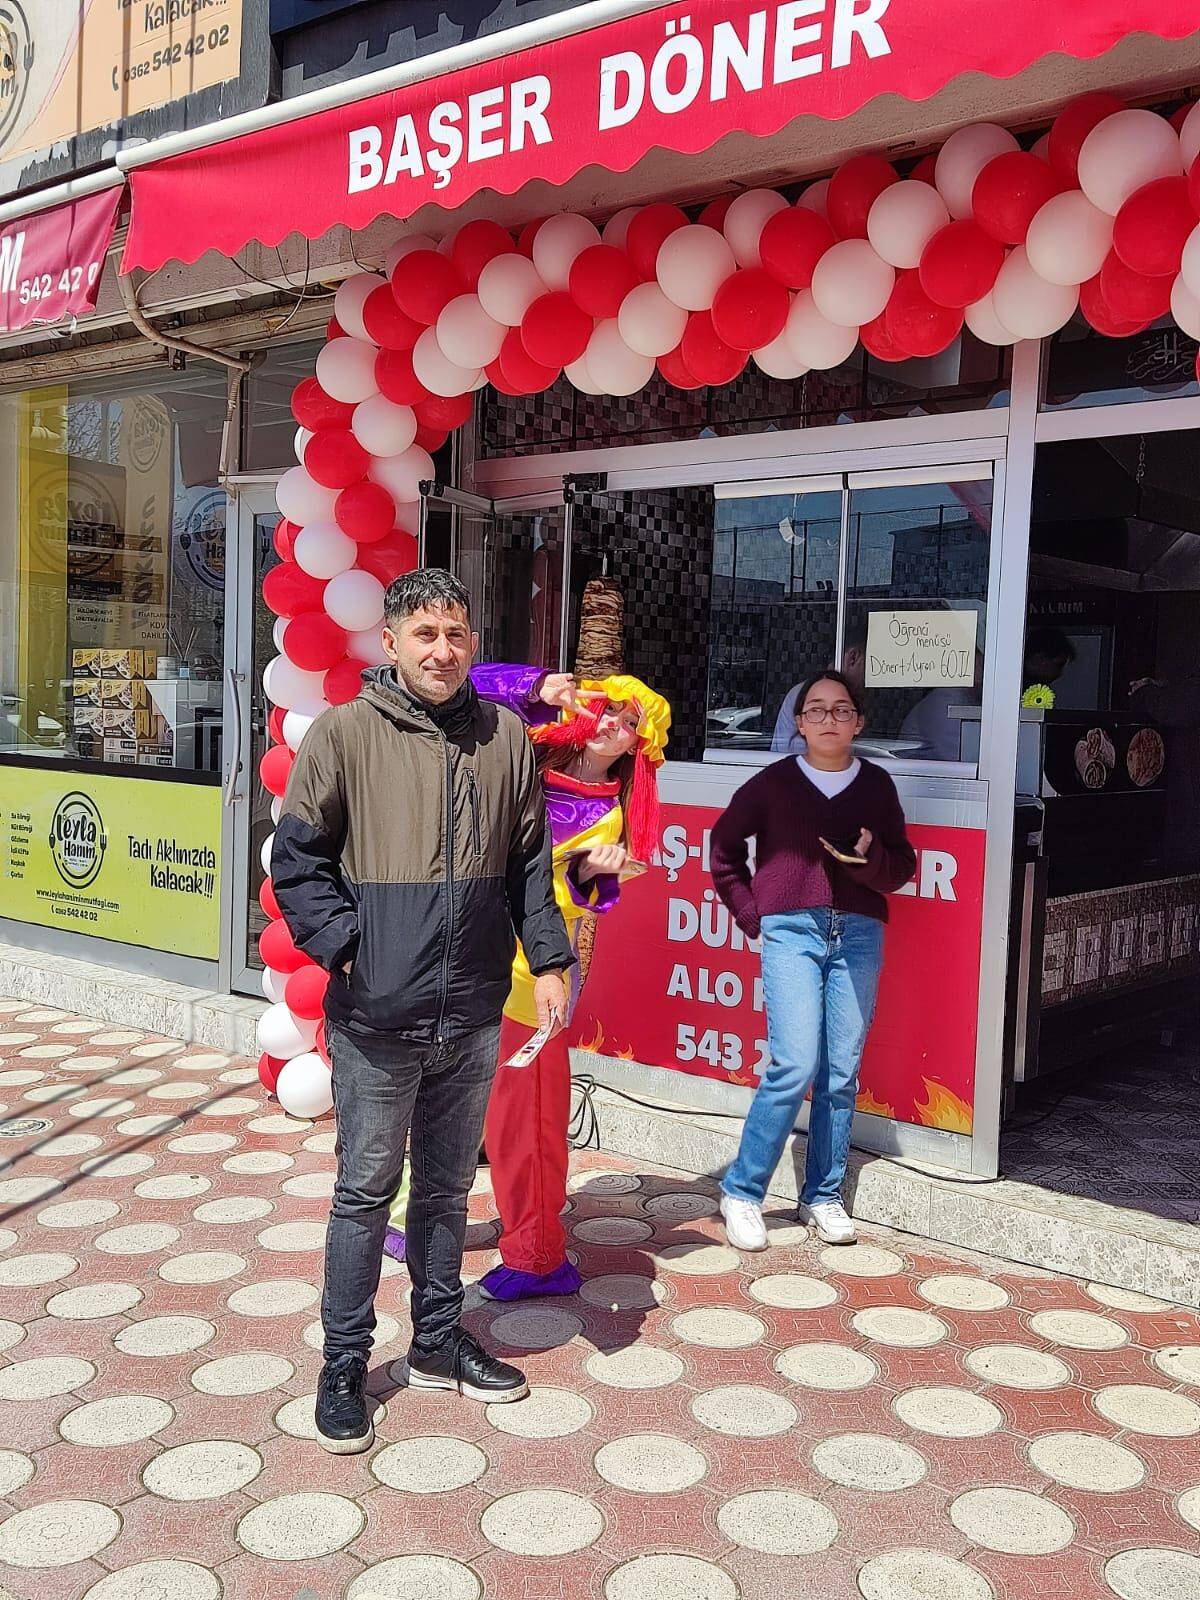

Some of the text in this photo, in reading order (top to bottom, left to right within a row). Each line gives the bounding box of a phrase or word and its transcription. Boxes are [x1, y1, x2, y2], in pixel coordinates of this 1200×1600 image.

[124, 24, 229, 82] 0362 542 42 02
[347, 0, 892, 194] BAŞER DÖNER
[19, 273, 53, 305] 542
[58, 265, 83, 294] 42
[64, 840, 96, 859] Hanım
[128, 835, 216, 869] Tadı Aklınızda
[666, 963, 743, 1008] ALO
[675, 1023, 743, 1071] 543
